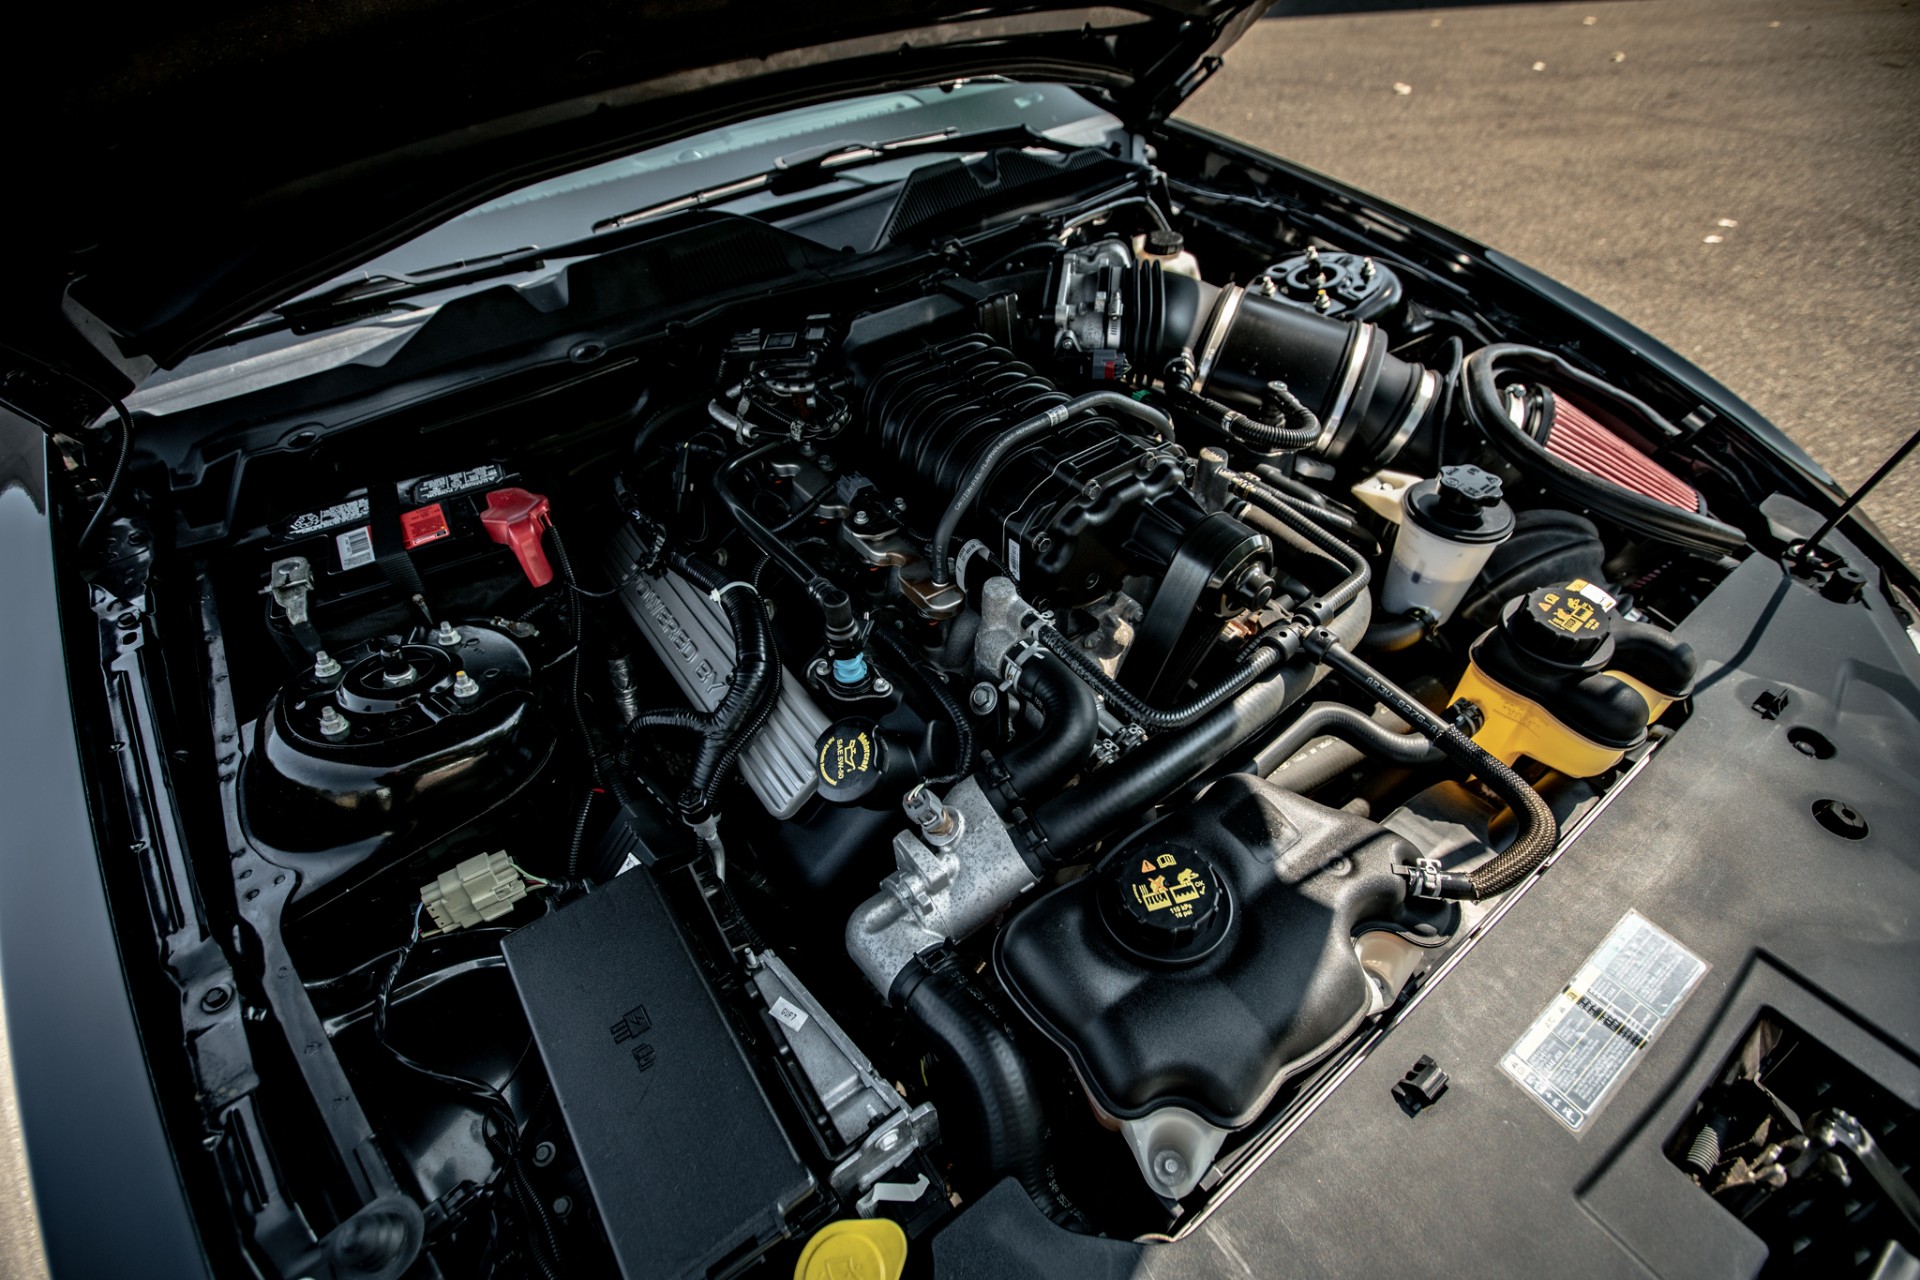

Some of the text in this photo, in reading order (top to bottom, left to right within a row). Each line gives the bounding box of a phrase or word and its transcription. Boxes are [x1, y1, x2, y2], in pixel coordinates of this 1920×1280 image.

[696, 658, 726, 695] BY
[836, 738, 845, 780] SAE 5W-50
[857, 732, 871, 772] Motorcraft
[1194, 880, 1205, 888] OK
